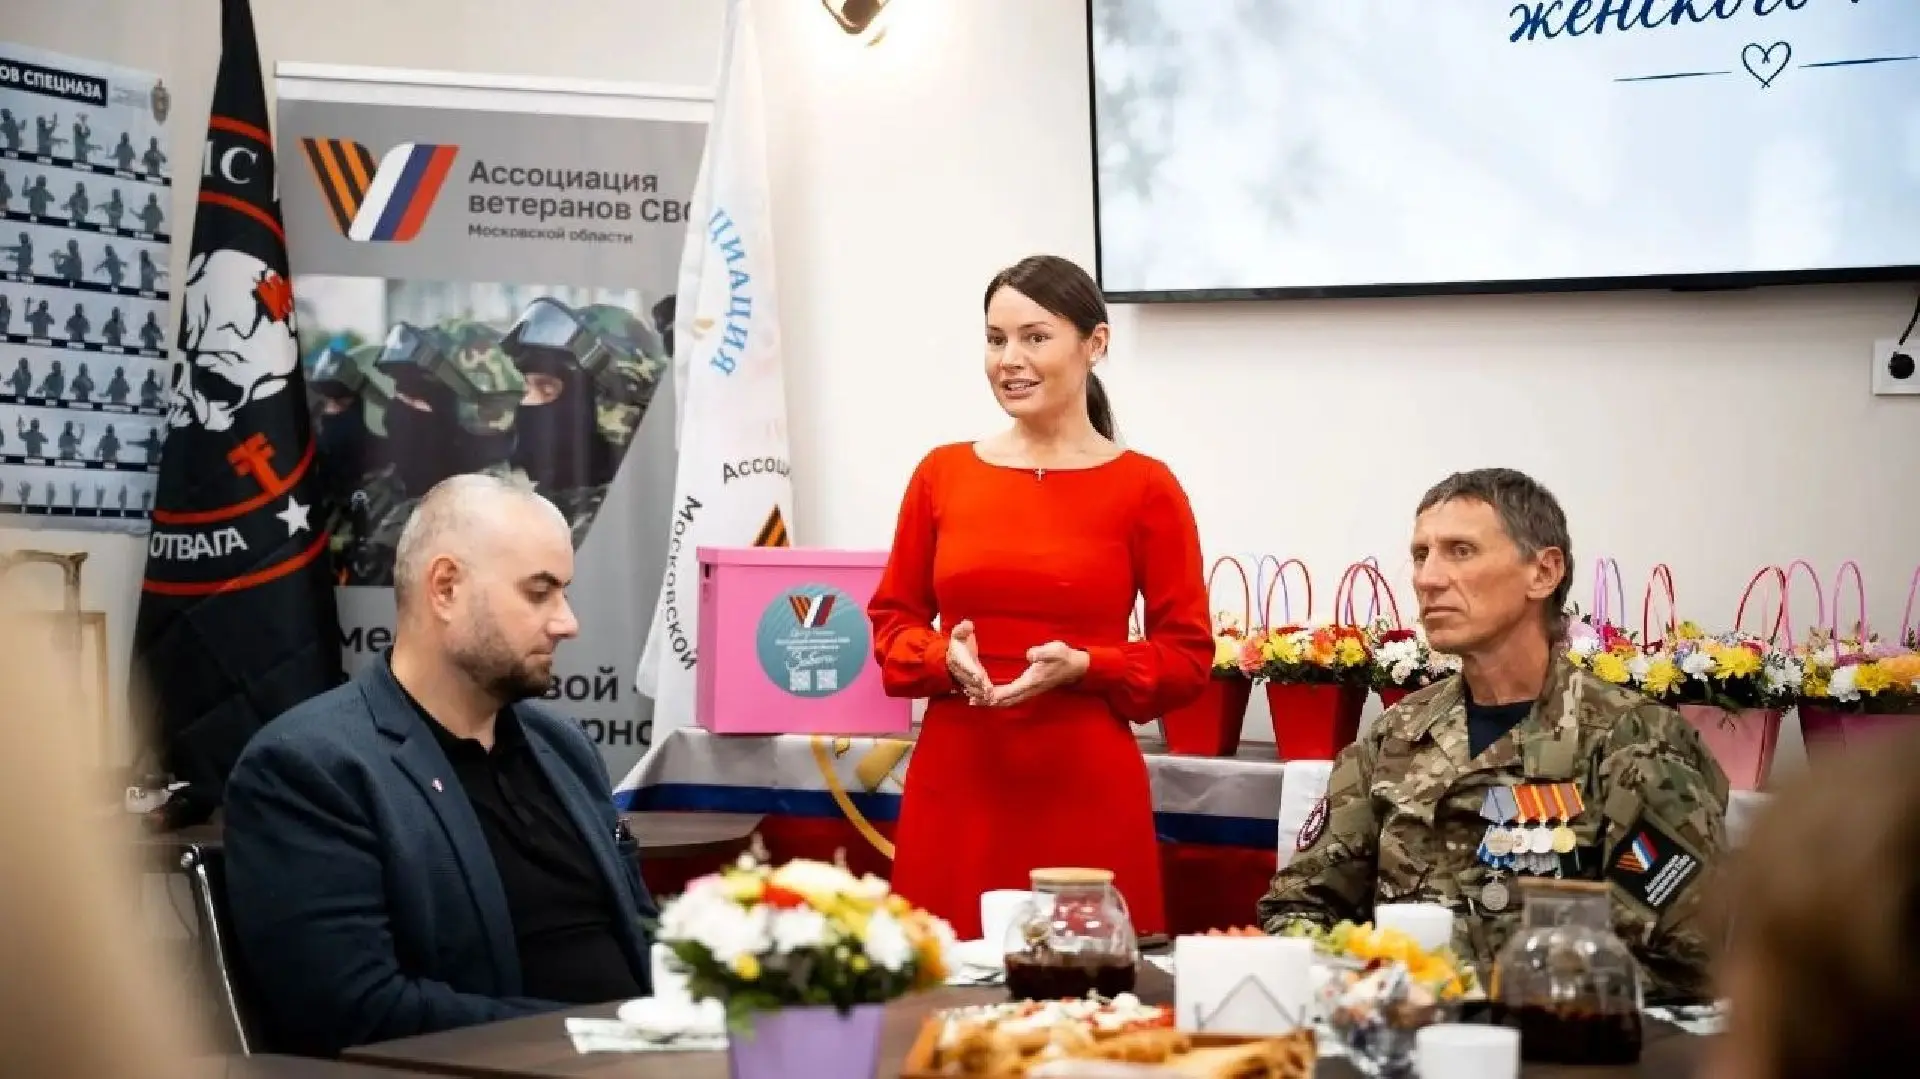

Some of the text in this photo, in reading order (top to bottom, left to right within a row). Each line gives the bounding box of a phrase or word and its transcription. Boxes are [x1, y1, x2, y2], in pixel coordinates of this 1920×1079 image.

[23, 69, 103, 100] СПЕЦНАЗА
[468, 159, 658, 195] Ассоциация
[468, 195, 631, 222] ветеранов
[468, 223, 634, 245] Московской области
[150, 526, 249, 561] ОТВАГА
